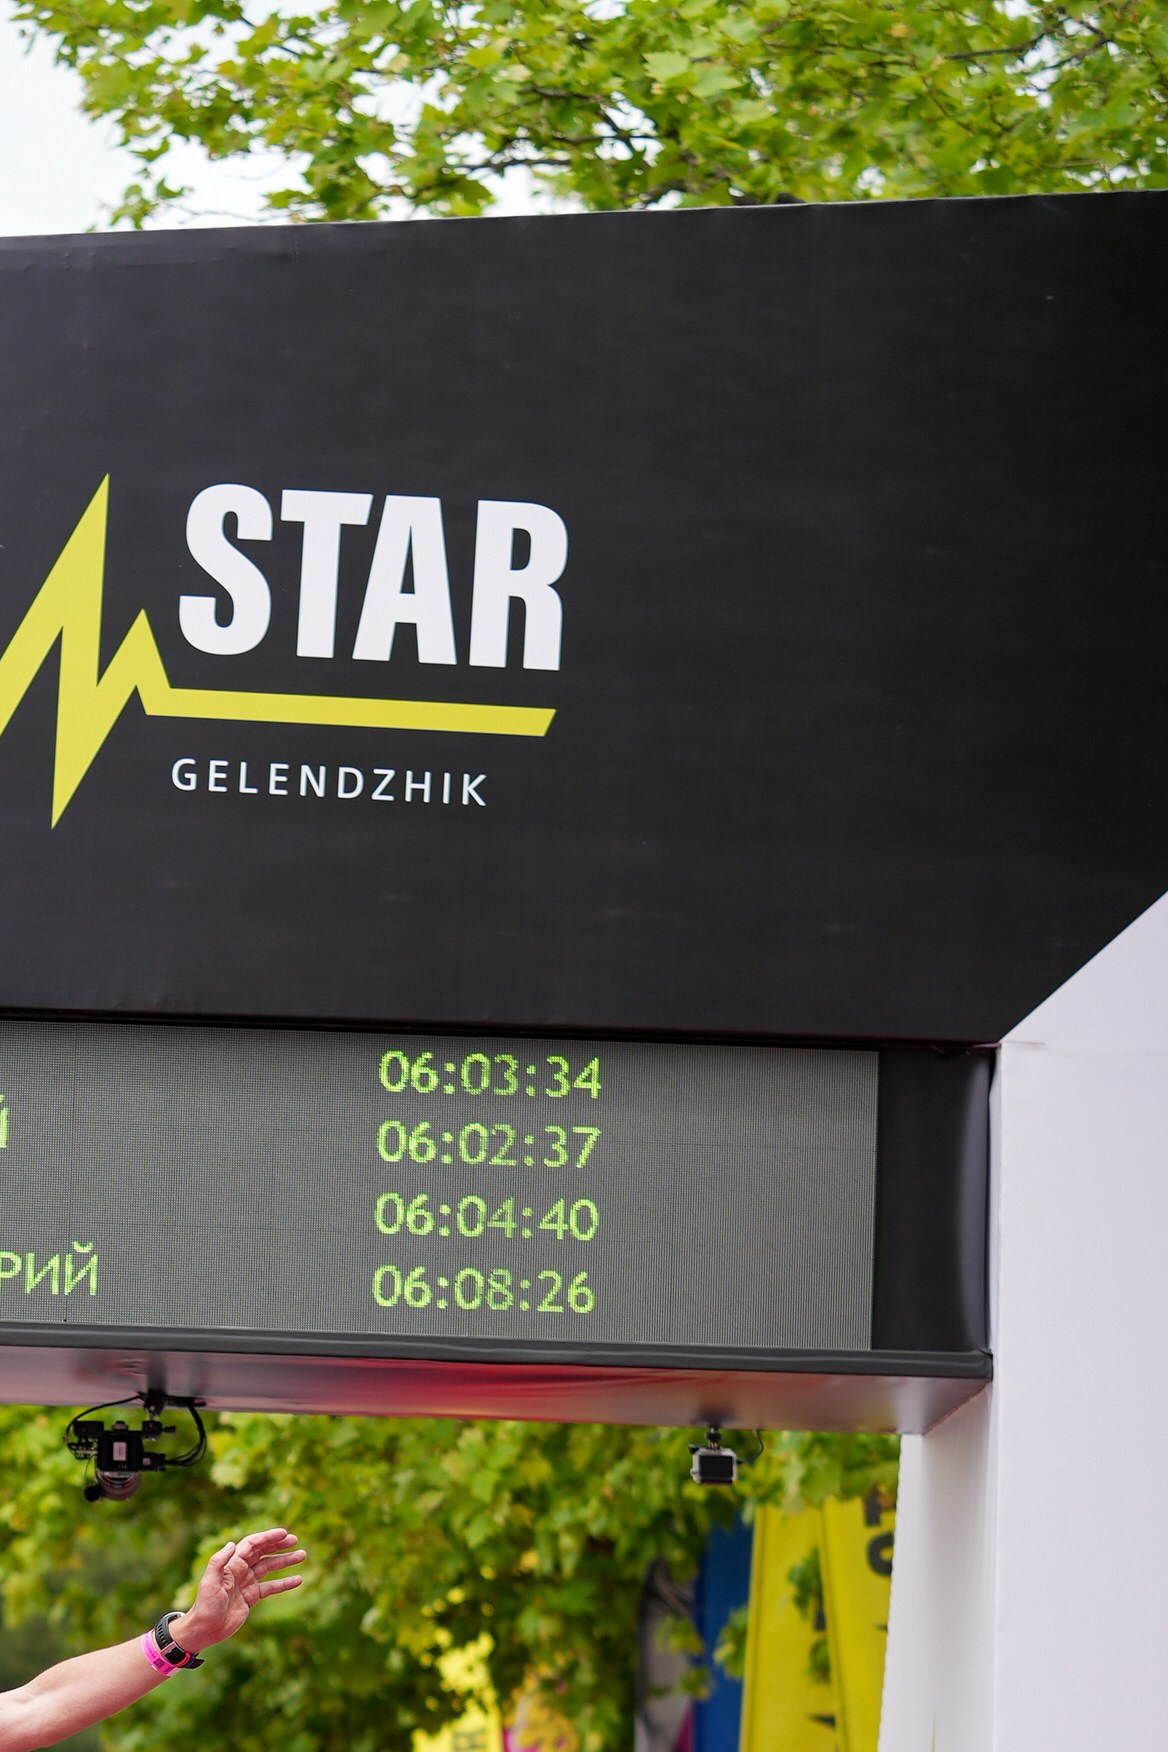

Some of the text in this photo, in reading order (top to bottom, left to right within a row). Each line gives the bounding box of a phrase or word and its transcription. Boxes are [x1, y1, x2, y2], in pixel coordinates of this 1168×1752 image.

[180, 484, 568, 671] STAR
[171, 758, 487, 806] GELENDZHIK
[379, 1050, 602, 1099] 06:03:34
[377, 1120, 602, 1168] 06:02:37
[374, 1192, 600, 1240] 06:04:40
[372, 1264, 596, 1313] 06:08:26
